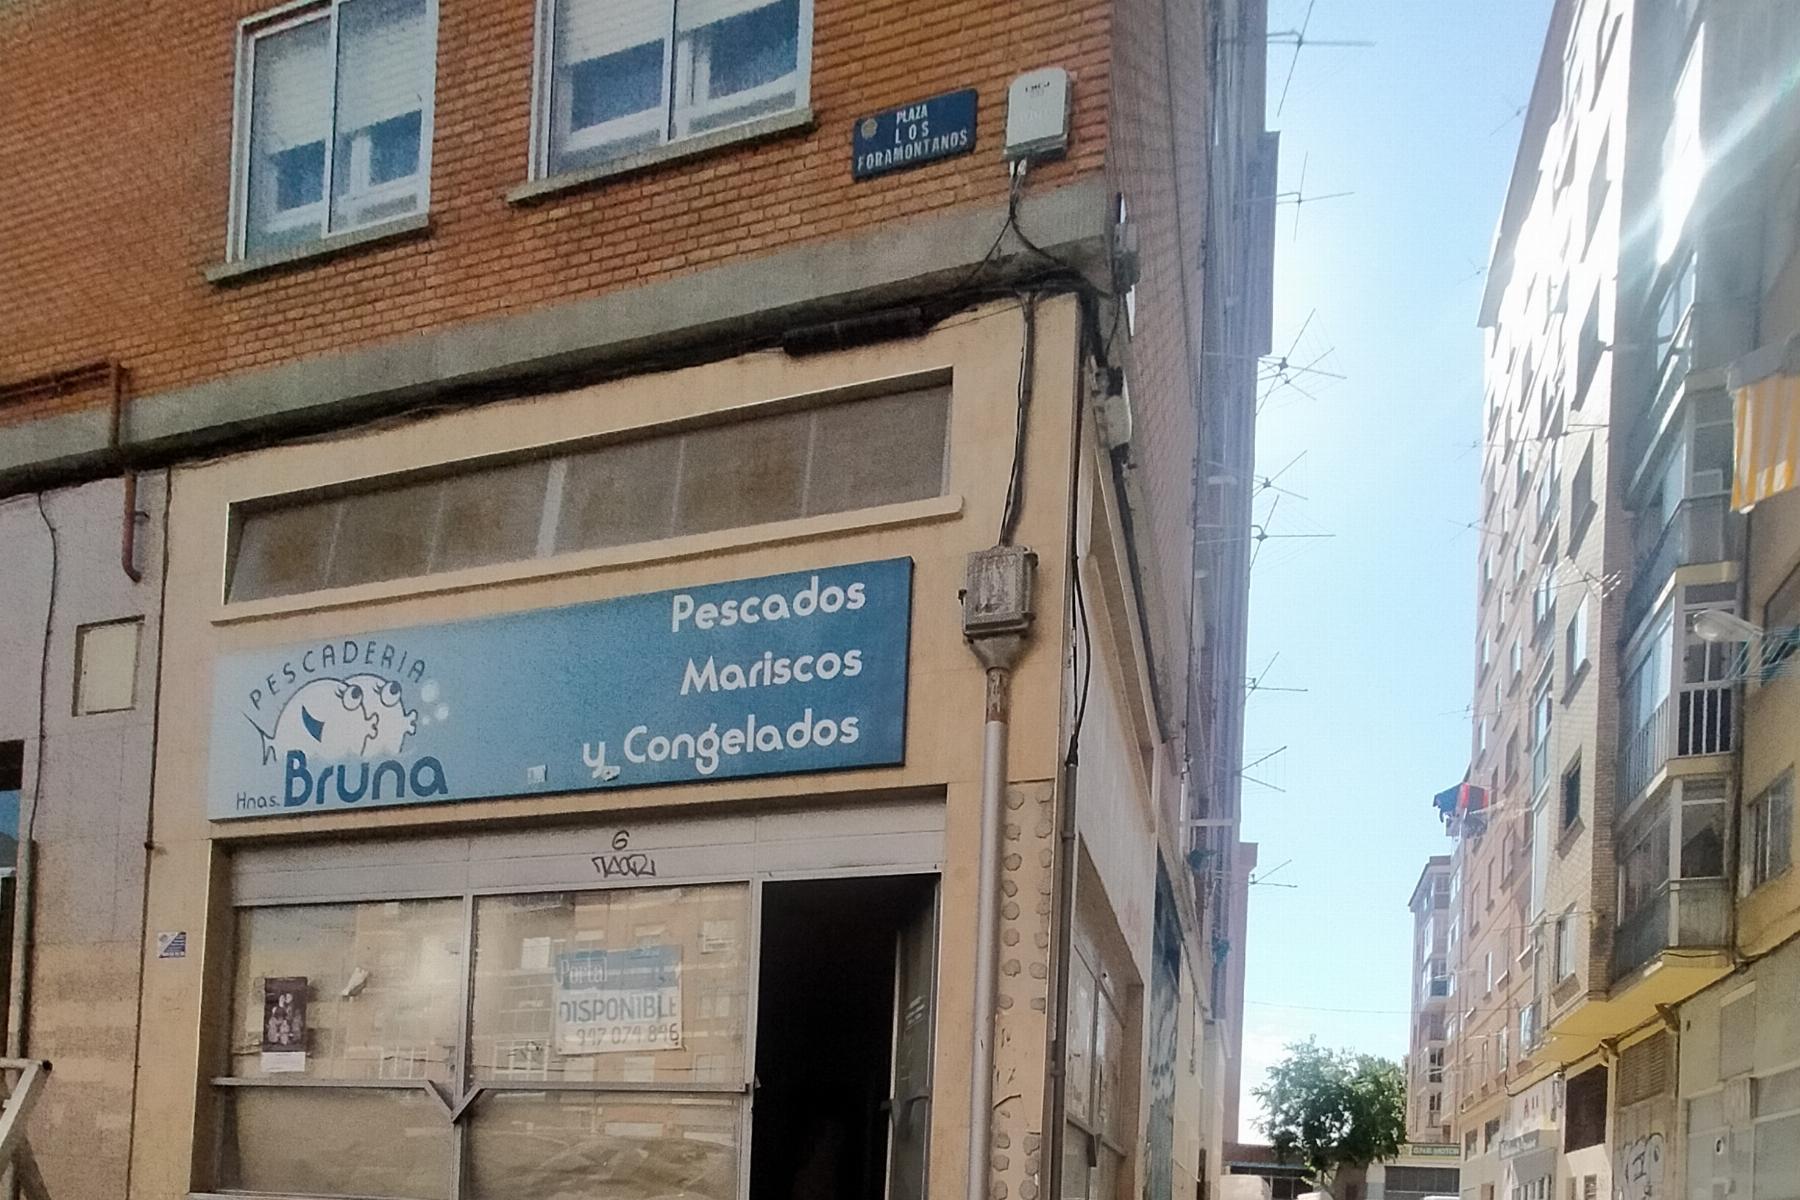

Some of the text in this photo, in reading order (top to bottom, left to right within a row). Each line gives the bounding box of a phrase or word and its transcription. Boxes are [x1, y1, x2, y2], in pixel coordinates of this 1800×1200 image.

[895, 121, 929, 144] LOS
[896, 104, 928, 124] PLAZA
[857, 129, 968, 171] FORAMONTANOS
[672, 576, 866, 632] Pescados
[251, 641, 425, 710] PESCADERIA
[680, 650, 863, 695] Mariscos
[583, 708, 860, 779] y Congelados
[236, 750, 449, 810] Hnas. Bruna
[559, 995, 678, 1022] DISPONIBLE
